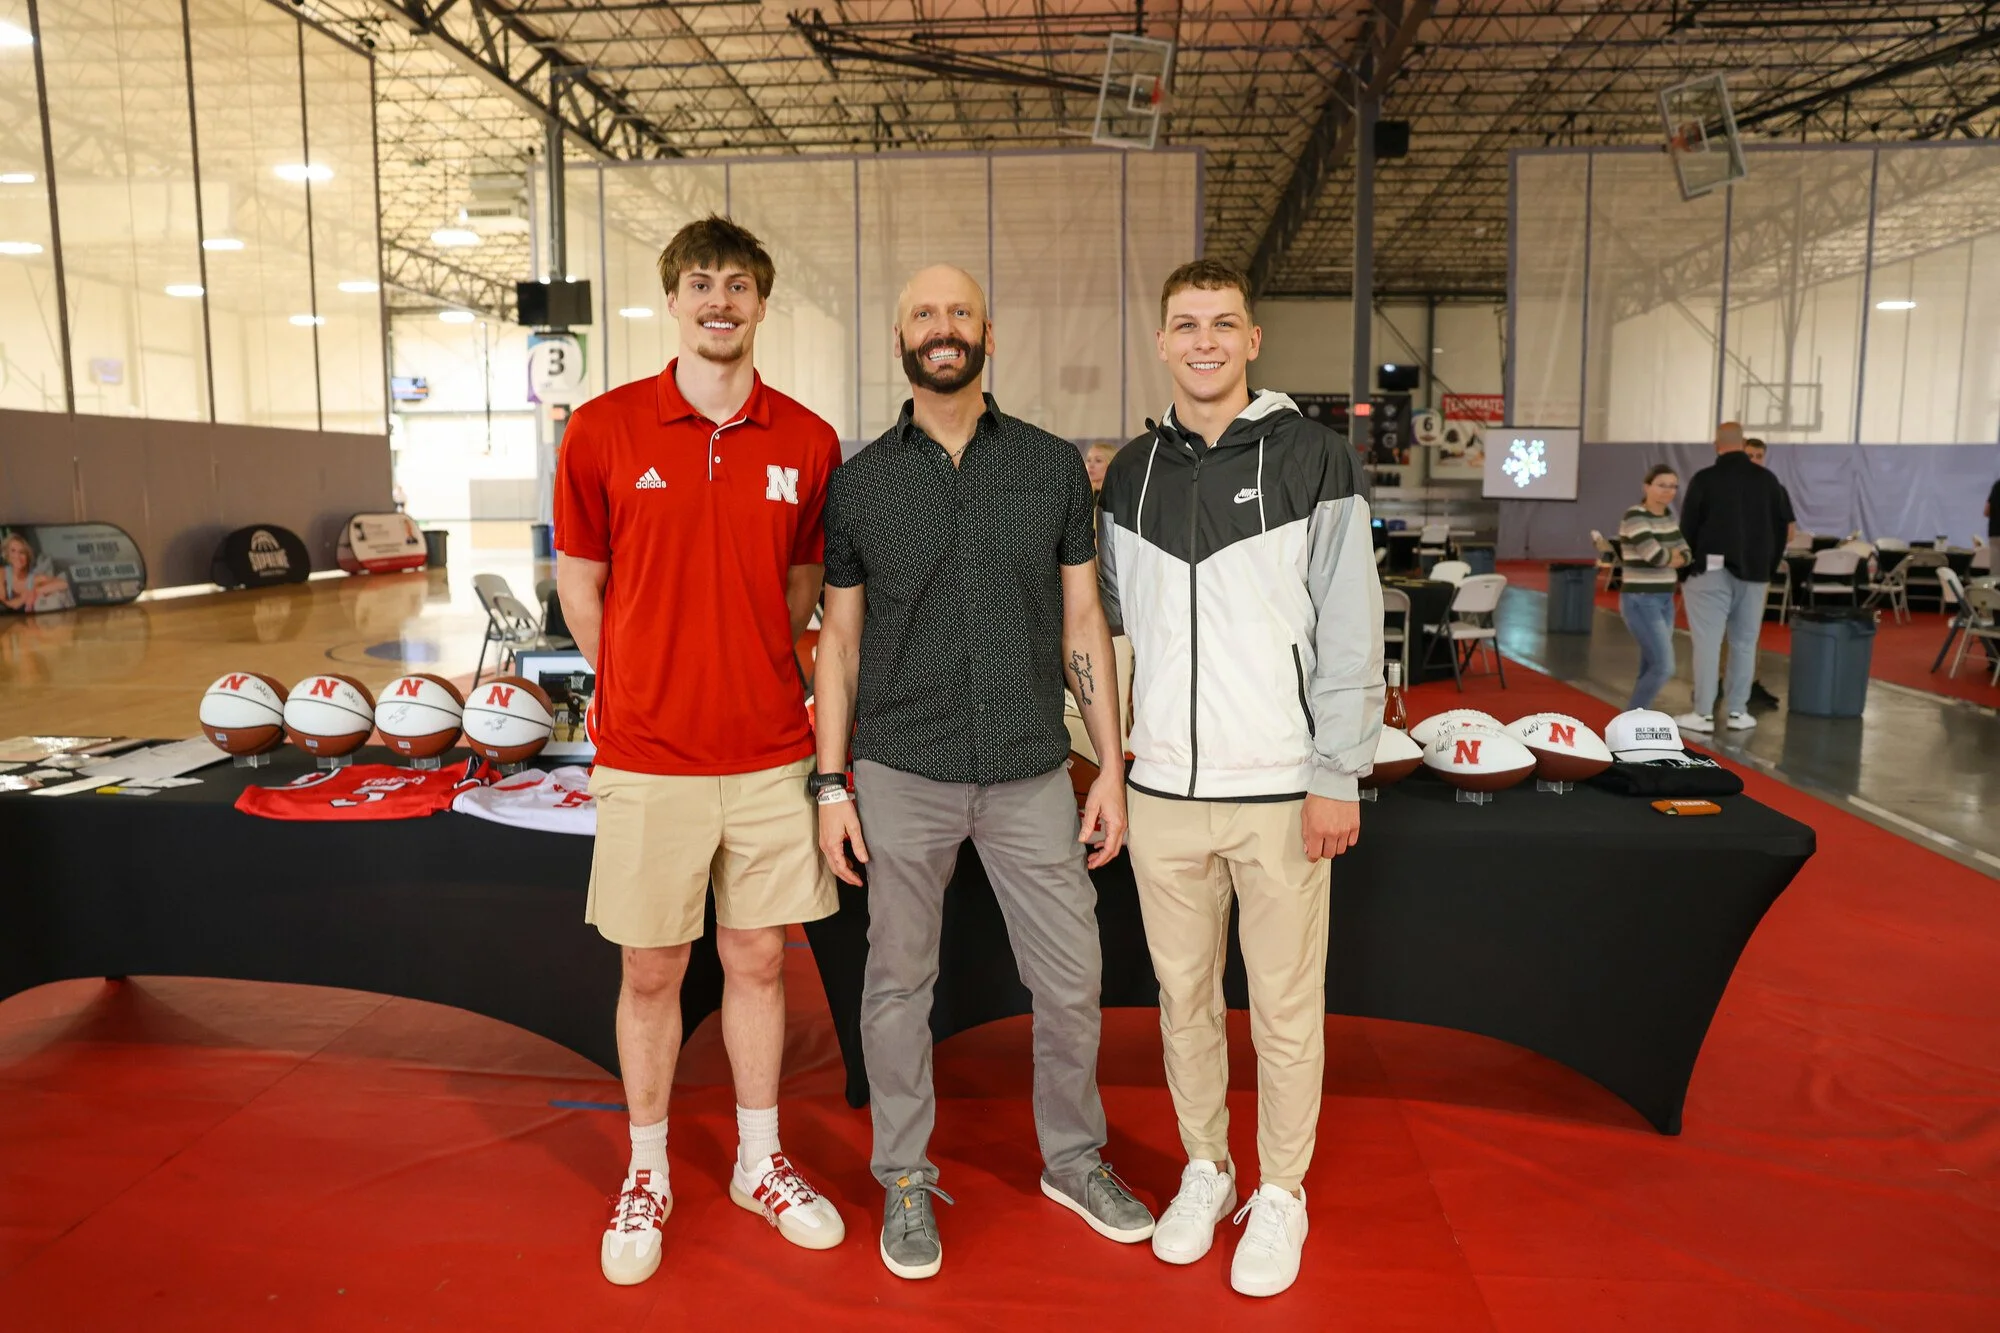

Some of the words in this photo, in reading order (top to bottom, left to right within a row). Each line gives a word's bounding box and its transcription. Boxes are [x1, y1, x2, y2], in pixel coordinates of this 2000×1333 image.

[548, 347, 565, 376] 3
[1444, 397, 1505, 414] TEAMMATE
[1423, 416, 1433, 431] 6
[635, 480, 666, 489] adidas
[765, 464, 799, 505] N
[1238, 488, 1258, 498] NIKE
[220, 674, 250, 691] N
[310, 679, 339, 699] N
[395, 679, 424, 697] N
[486, 685, 515, 708] N
[1548, 721, 1576, 748] N
[1453, 740, 1481, 765] N
